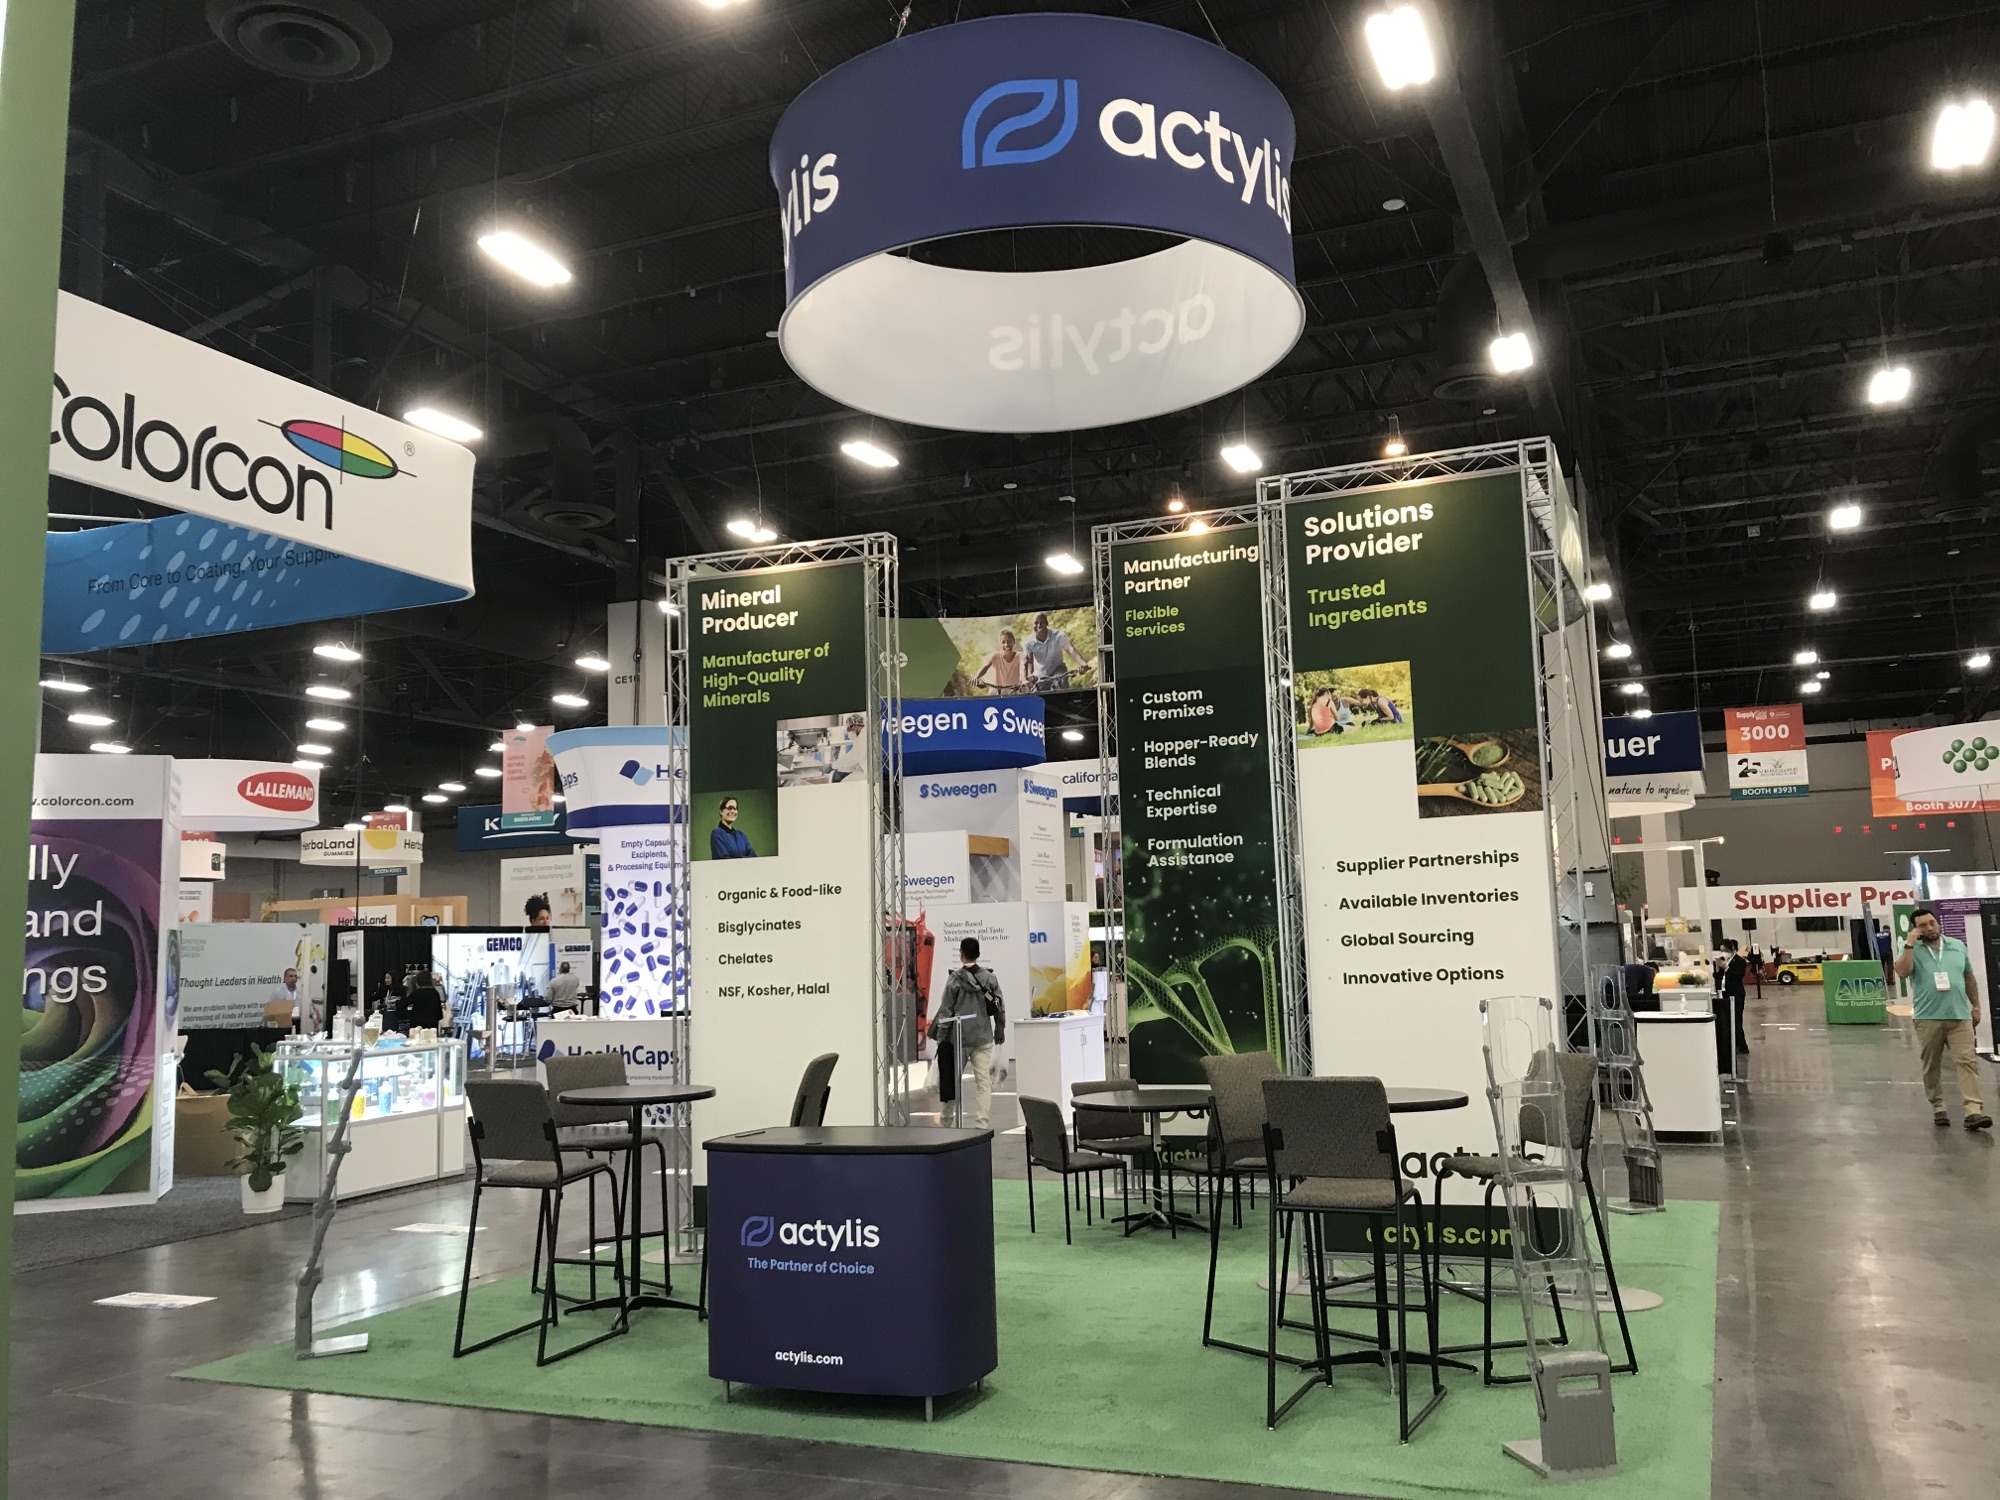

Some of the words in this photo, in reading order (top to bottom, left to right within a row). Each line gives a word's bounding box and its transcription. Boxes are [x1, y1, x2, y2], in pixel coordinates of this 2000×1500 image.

[1100, 97, 1292, 235] actylis
[1304, 502, 1434, 538] Solutions
[1305, 529, 1423, 565] Provider
[1123, 543, 1260, 575] Manufacturing
[88, 576, 124, 595] From
[129, 573, 162, 590] Core
[167, 572, 181, 585] to
[187, 561, 245, 582] Coating,
[248, 554, 280, 570] Your
[1124, 573, 1191, 595] Partner
[701, 584, 781, 611] Mineral
[1307, 579, 1386, 605] Trusted
[702, 610, 799, 635] Producer
[1125, 604, 1179, 623] Flexible
[1308, 598, 1428, 630] Ingredients
[1125, 620, 1185, 639] Services
[702, 646, 811, 669] Manufacturer
[813, 642, 830, 657] of
[702, 667, 805, 692] High-Quality
[703, 689, 770, 708] Minerals
[1142, 689, 1203, 705] Custom
[1143, 703, 1214, 721] Premixes
[1740, 724, 1790, 741] 3000
[1144, 731, 1259, 756] Hopper-Ready
[1603, 734, 1662, 759] uer
[1145, 753, 1196, 770] Blends
[245, 781, 314, 802] LALLEMAND
[931, 782, 997, 799] Sweegen
[1029, 779, 1058, 800] Sweegen
[1146, 783, 1221, 802] Technical
[1608, 782, 1641, 795] nature
[1646, 782, 1655, 794] to
[1742, 788, 1771, 796] BOOTH
[1773, 786, 1797, 794] #3931
[1146, 800, 1217, 821] Expertise
[1906, 801, 1944, 811] Booth
[621, 839, 644, 849] Empty
[1147, 832, 1244, 851] Formulation
[631, 850, 669, 859] Excipients,
[1147, 852, 1235, 868] Assistance
[1336, 856, 1405, 876] Supplier
[1408, 849, 1520, 868] Partnerships
[608, 863, 614, 871] &
[615, 861, 653, 872] Processing
[718, 888, 767, 904] Organic
[769, 888, 779, 899] &
[782, 883, 842, 898] Food-like
[1339, 892, 1418, 910] Available
[1421, 888, 1519, 906] Inventories
[1734, 888, 1852, 914] Supplier
[718, 918, 801, 936] Bisglycinates
[486, 938, 522, 951] GEMCO
[1341, 932, 1394, 947] Global
[1398, 928, 1474, 946] Sourcing
[718, 952, 773, 965] Chelates
[180, 977, 213, 989] Thought
[215, 977, 246, 987] Leaders
[248, 976, 256, 985] in
[257, 975, 282, 984] Health
[1343, 968, 1433, 985] Innovative
[1436, 966, 1505, 985] Options
[718, 986, 745, 999] NSF,
[747, 984, 794, 997] Kosher,
[797, 982, 830, 995] Halal
[779, 1218, 880, 1252] actylis
[748, 1257, 768, 1270] The
[770, 1259, 813, 1273] Partner
[815, 1261, 827, 1273] of
[829, 1262, 875, 1274] Choice
[775, 1351, 843, 1366] actylis.com
